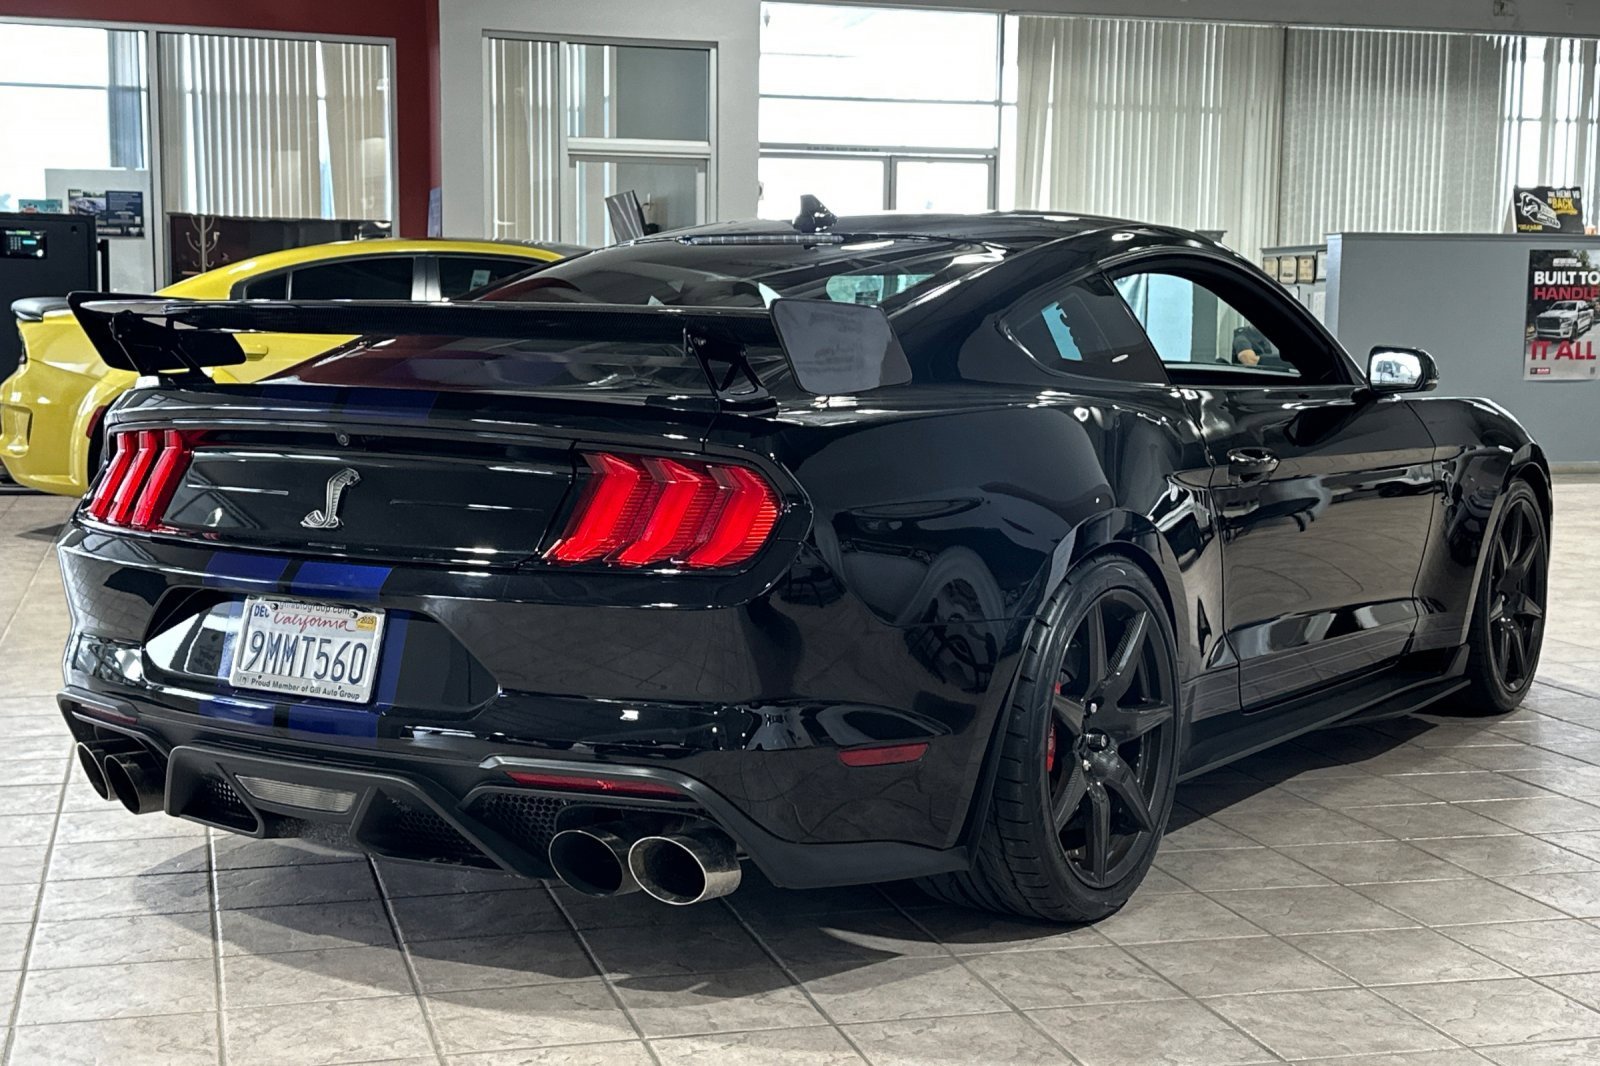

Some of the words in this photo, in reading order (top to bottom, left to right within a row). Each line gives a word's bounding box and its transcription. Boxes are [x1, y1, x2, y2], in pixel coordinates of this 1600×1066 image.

[1552, 198, 1574, 209] BACK
[1534, 271, 1577, 285] BUILT
[1578, 271, 1600, 285] TO
[1534, 287, 1600, 300] HANDLE
[1531, 340, 1552, 360] IT
[1554, 340, 1597, 360] ALL
[273, 612, 355, 633] California
[244, 630, 367, 685] 9MMT560
[251, 678, 271, 688] Proud
[272, 681, 300, 692] Member
[310, 686, 321, 695] Gill
[322, 688, 338, 697] Auto
[339, 690, 360, 700] Group
